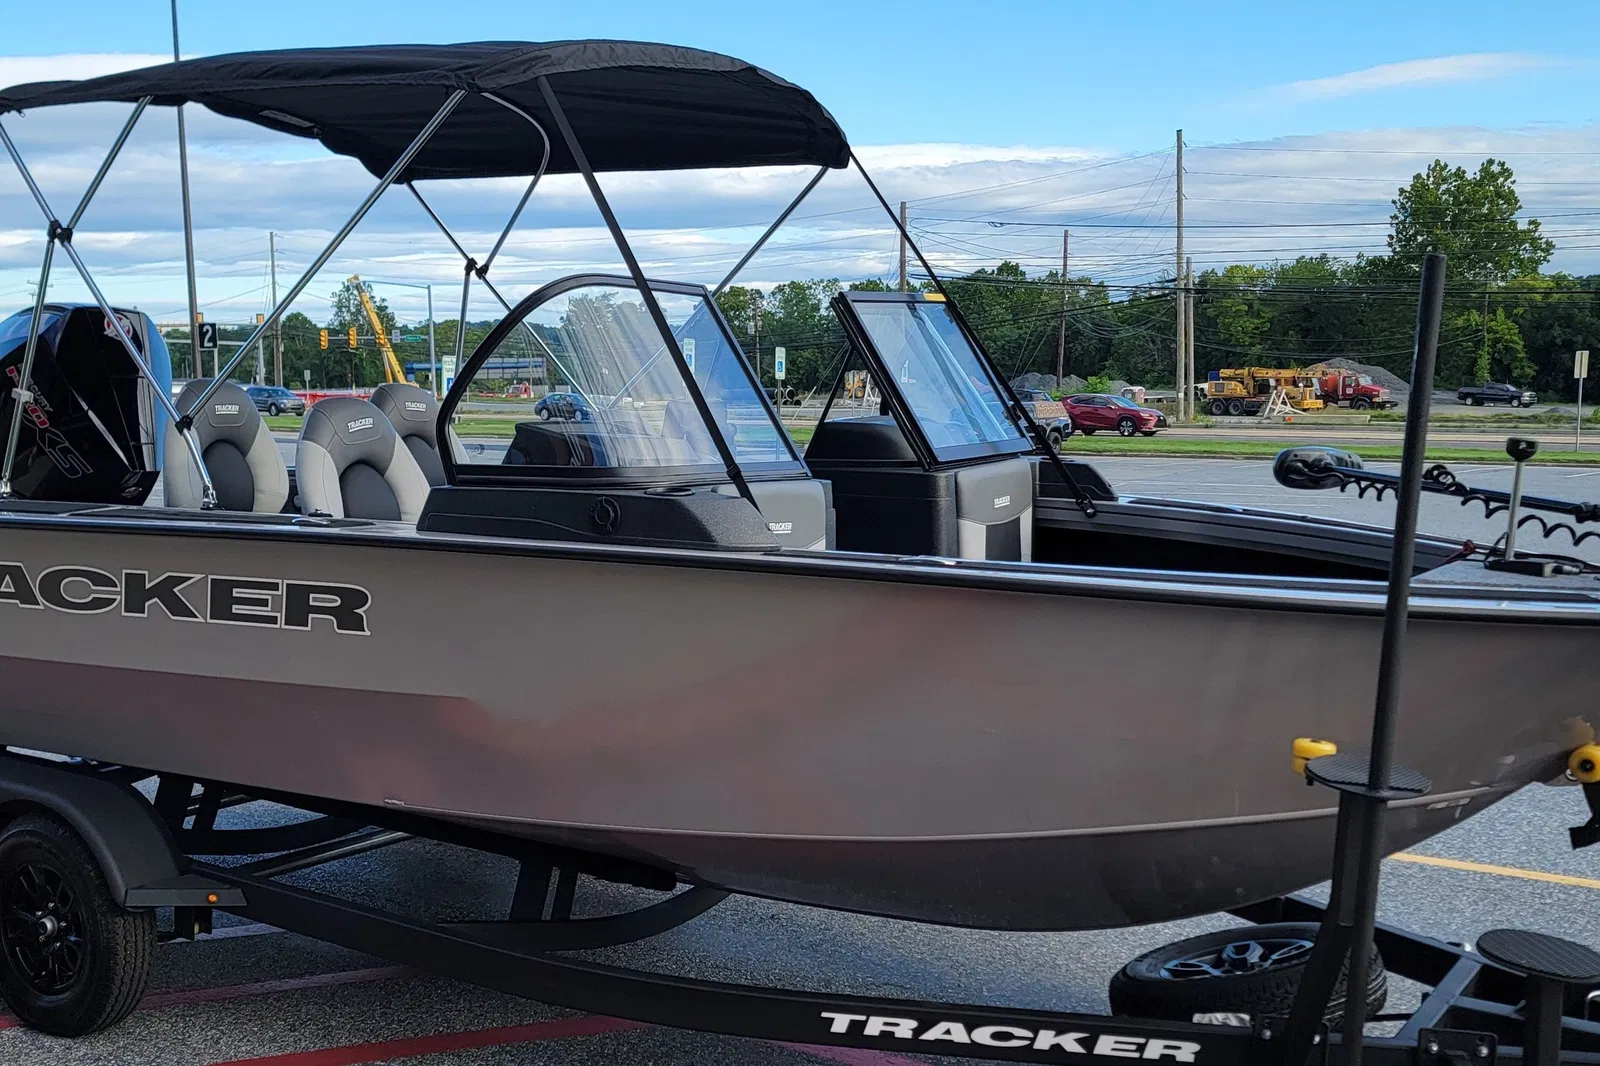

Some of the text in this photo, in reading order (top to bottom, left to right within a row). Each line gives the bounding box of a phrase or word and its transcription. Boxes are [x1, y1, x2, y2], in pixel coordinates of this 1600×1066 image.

[203, 324, 213, 347] 2
[17, 363, 54, 412] CURY
[215, 404, 239, 412] TRACKER
[348, 418, 373, 429] TRACKER
[769, 522, 792, 530] TRACKER
[0, 562, 372, 635] ACKER
[820, 1011, 1202, 1062] TRACKER
